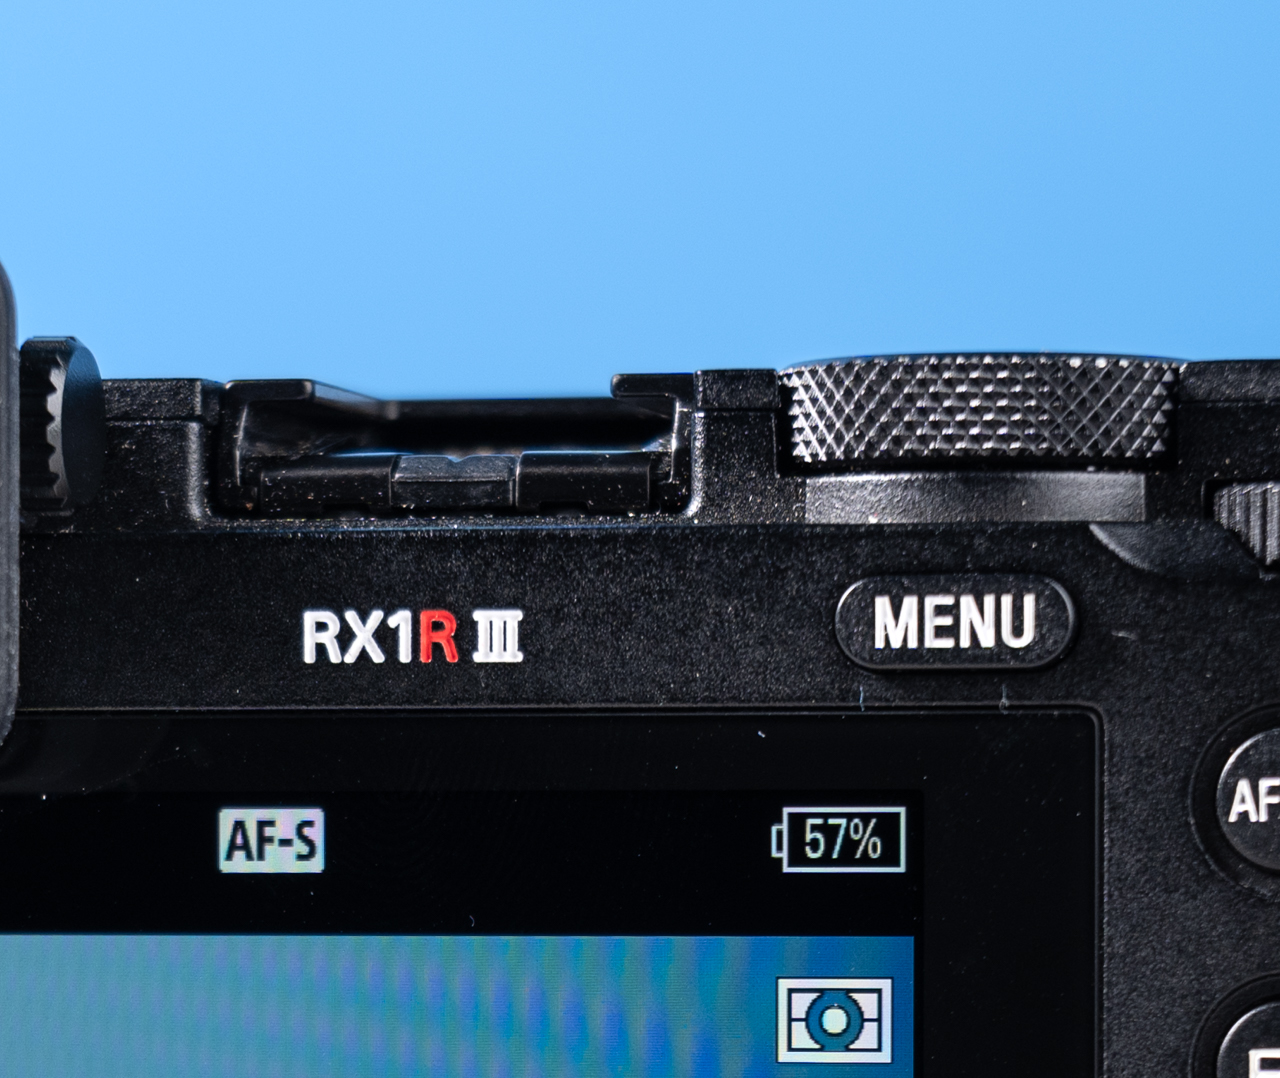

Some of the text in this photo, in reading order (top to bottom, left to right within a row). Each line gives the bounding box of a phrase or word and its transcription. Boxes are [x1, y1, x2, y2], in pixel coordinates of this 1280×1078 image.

[302, 609, 459, 664] RX1R
[874, 593, 1037, 650] MENU
[224, 819, 318, 863] AF-S
[804, 817, 882, 860] 57%
